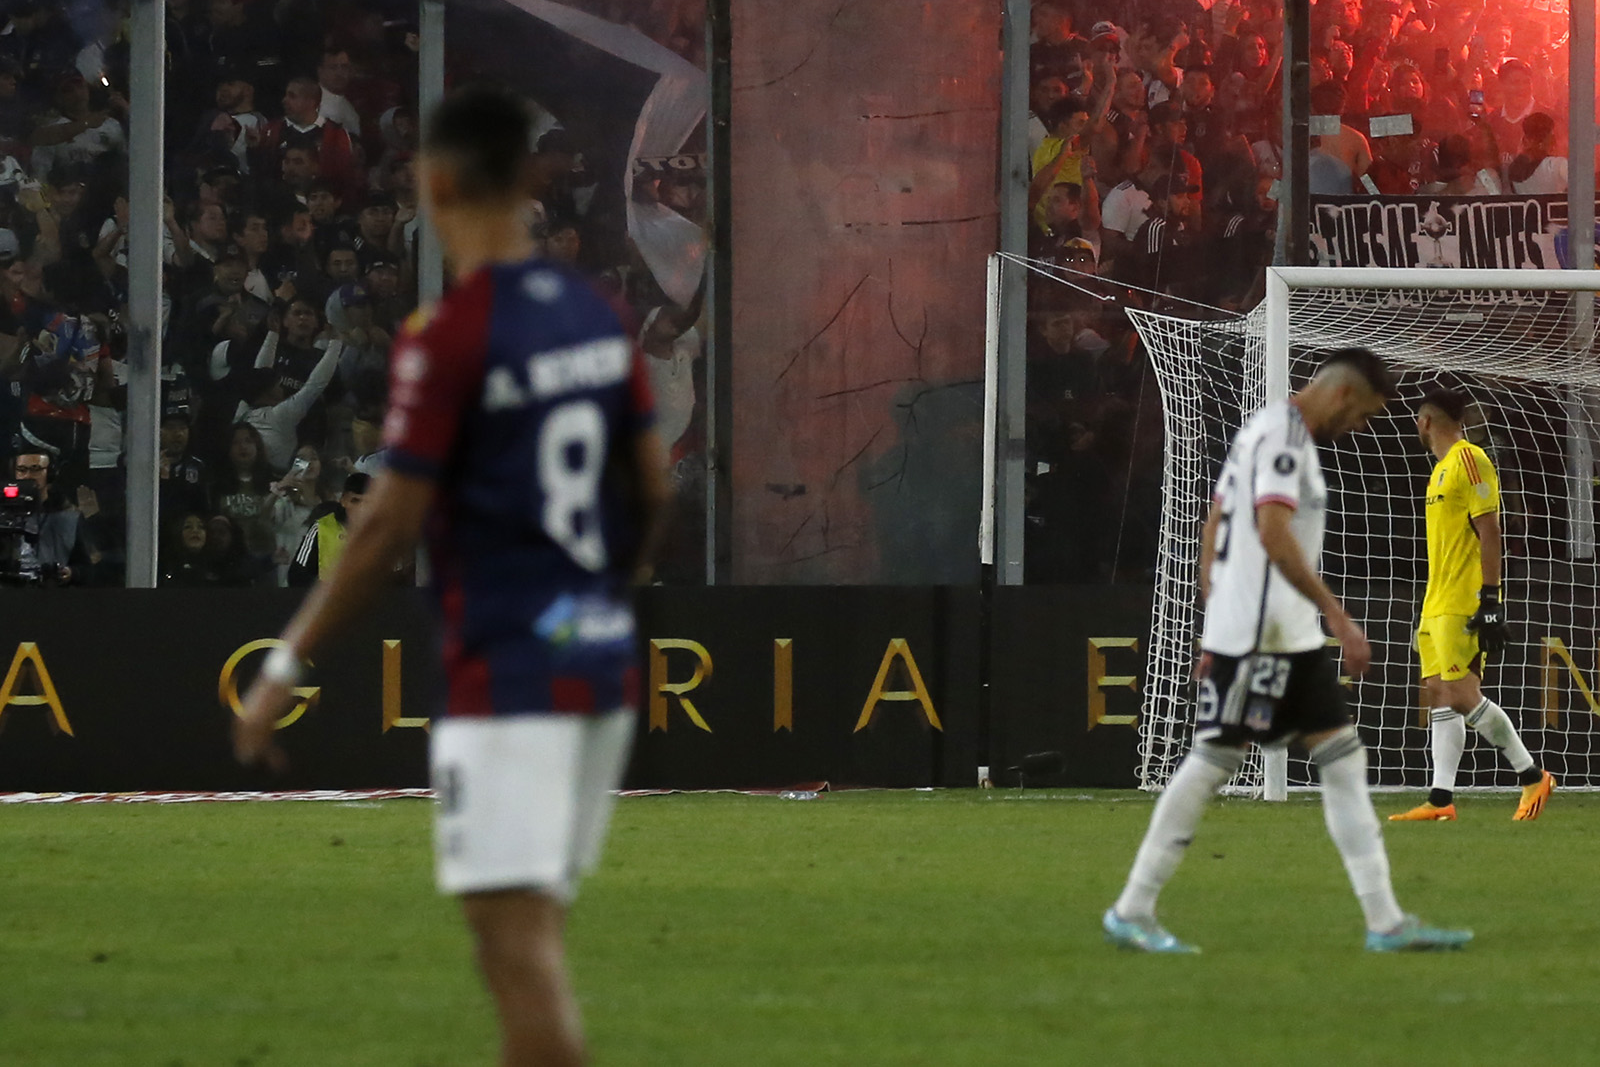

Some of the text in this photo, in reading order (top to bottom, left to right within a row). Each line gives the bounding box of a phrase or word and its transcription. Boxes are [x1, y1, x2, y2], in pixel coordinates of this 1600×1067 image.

[537, 399, 609, 574] 8
[217, 636, 944, 736] GLRIA
[1250, 655, 1293, 698] 23
